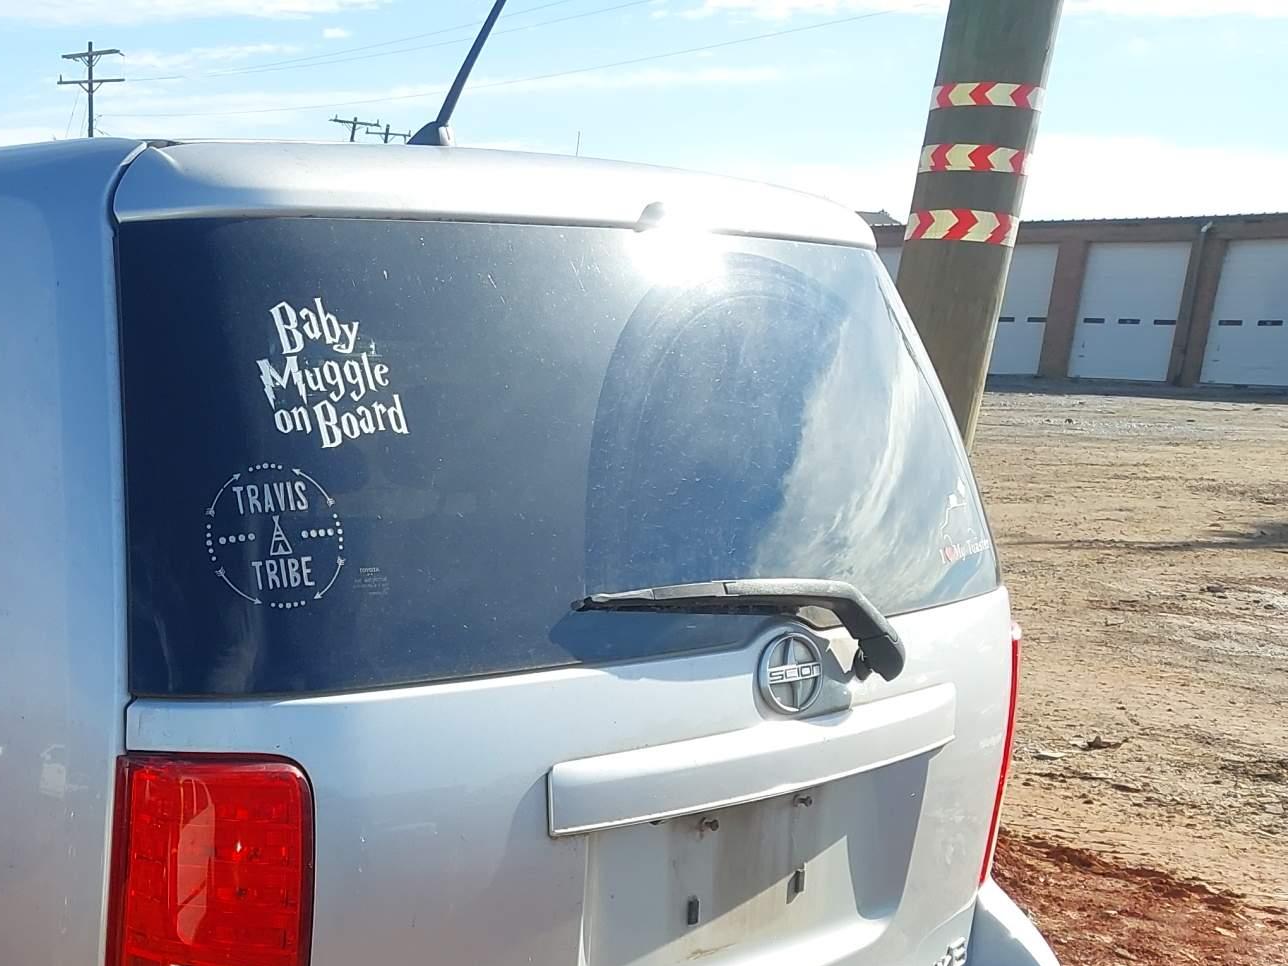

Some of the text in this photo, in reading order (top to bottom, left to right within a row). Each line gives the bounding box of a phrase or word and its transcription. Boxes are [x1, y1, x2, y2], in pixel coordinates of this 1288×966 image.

[269, 298, 360, 354] Baby
[256, 352, 389, 412] Muggle
[274, 394, 410, 448] on Board
[232, 480, 309, 515] TRAVIS
[251, 555, 315, 591] TRIBE
